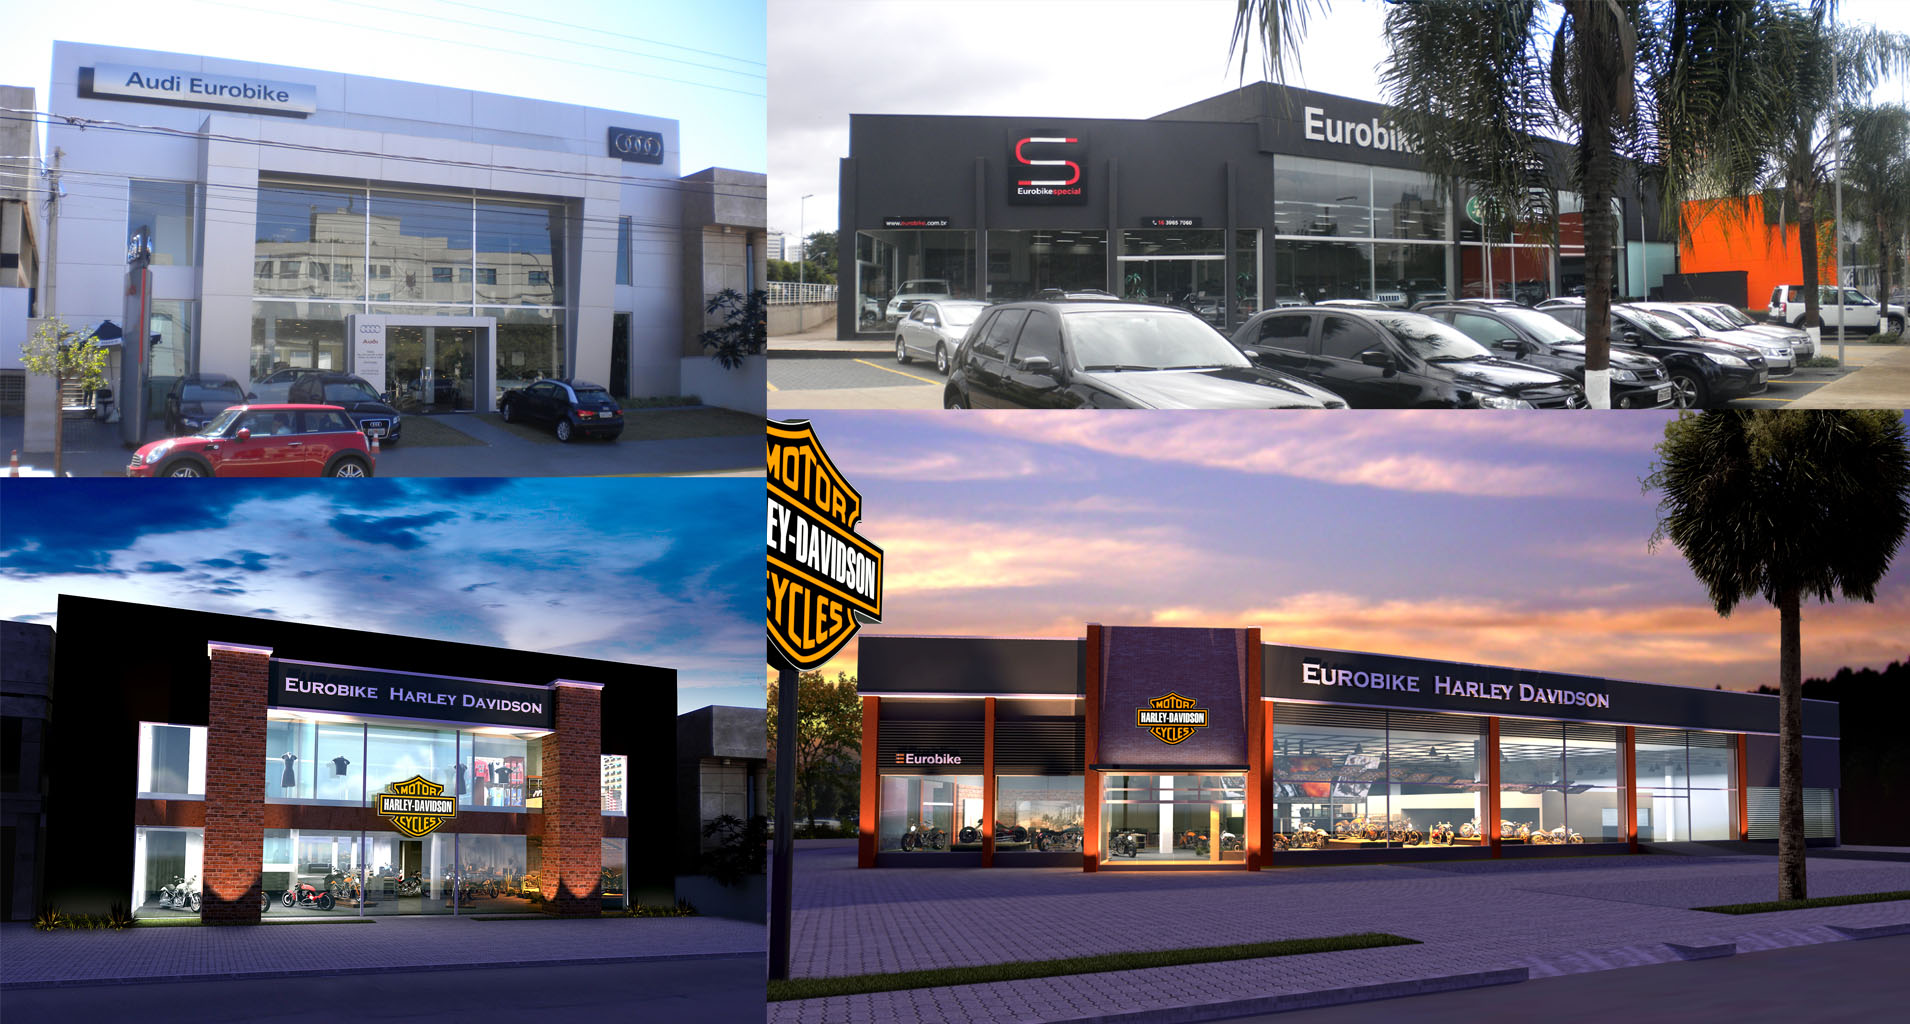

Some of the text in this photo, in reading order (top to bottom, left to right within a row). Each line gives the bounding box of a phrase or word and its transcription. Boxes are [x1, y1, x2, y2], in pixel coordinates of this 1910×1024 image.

[125, 71, 290, 103] Audi Eurobike
[767, 441, 847, 526] MOTOR
[767, 570, 843, 650] YCLES
[1302, 663, 1609, 709] EUROBIKE HARLEY DAVIDSON
[284, 677, 543, 714] EUROBIKE HARLEY DAVIDSON
[1155, 696, 1190, 709] MOTOR
[1140, 712, 1205, 724] HARLEY-DAVIDSON
[1155, 727, 1190, 741] CYCLES
[905, 753, 962, 764] Eurobike
[400, 781, 437, 796] MOTOR
[383, 798, 452, 813] HARLEY-DAVIDSON
[399, 816, 437, 833] CYCLES
